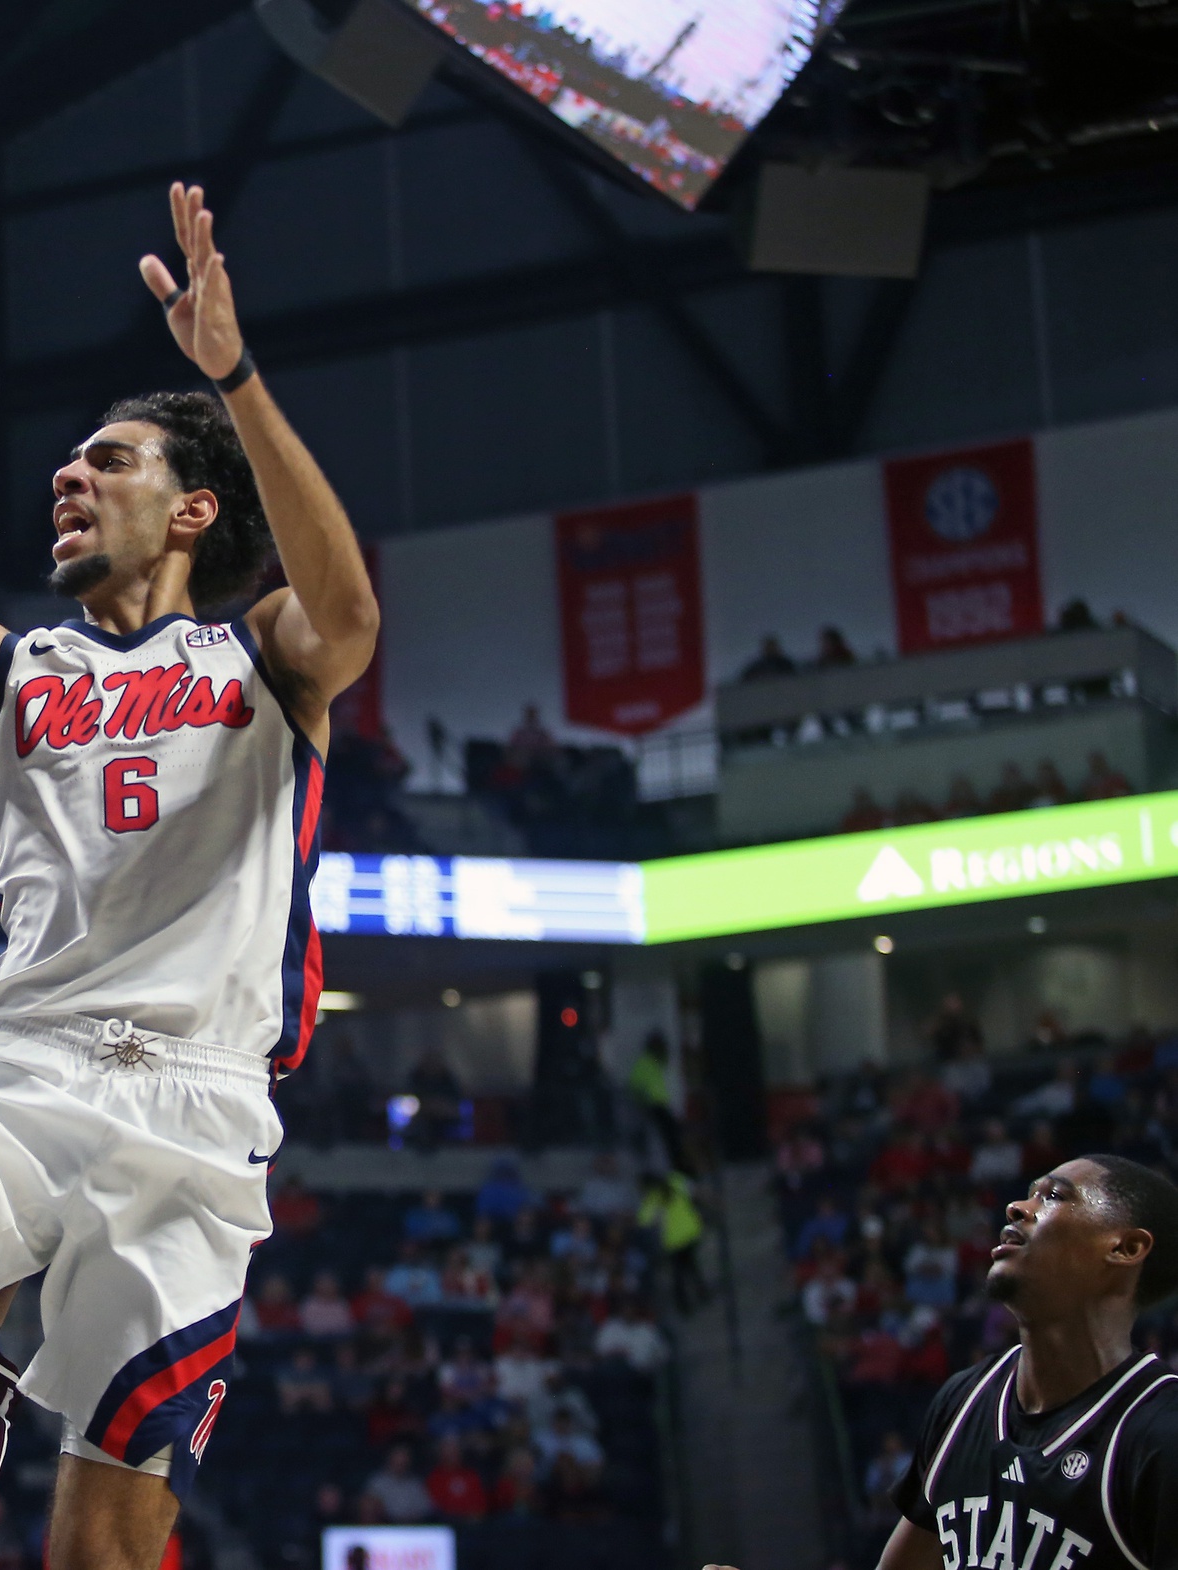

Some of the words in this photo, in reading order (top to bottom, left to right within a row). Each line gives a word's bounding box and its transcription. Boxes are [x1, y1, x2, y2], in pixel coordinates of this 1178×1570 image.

[187, 625, 227, 647] SEC
[15, 673, 103, 758] Ole
[102, 662, 255, 740] Miss
[103, 756, 159, 834] 6
[1062, 1451, 1088, 1478] SEC
